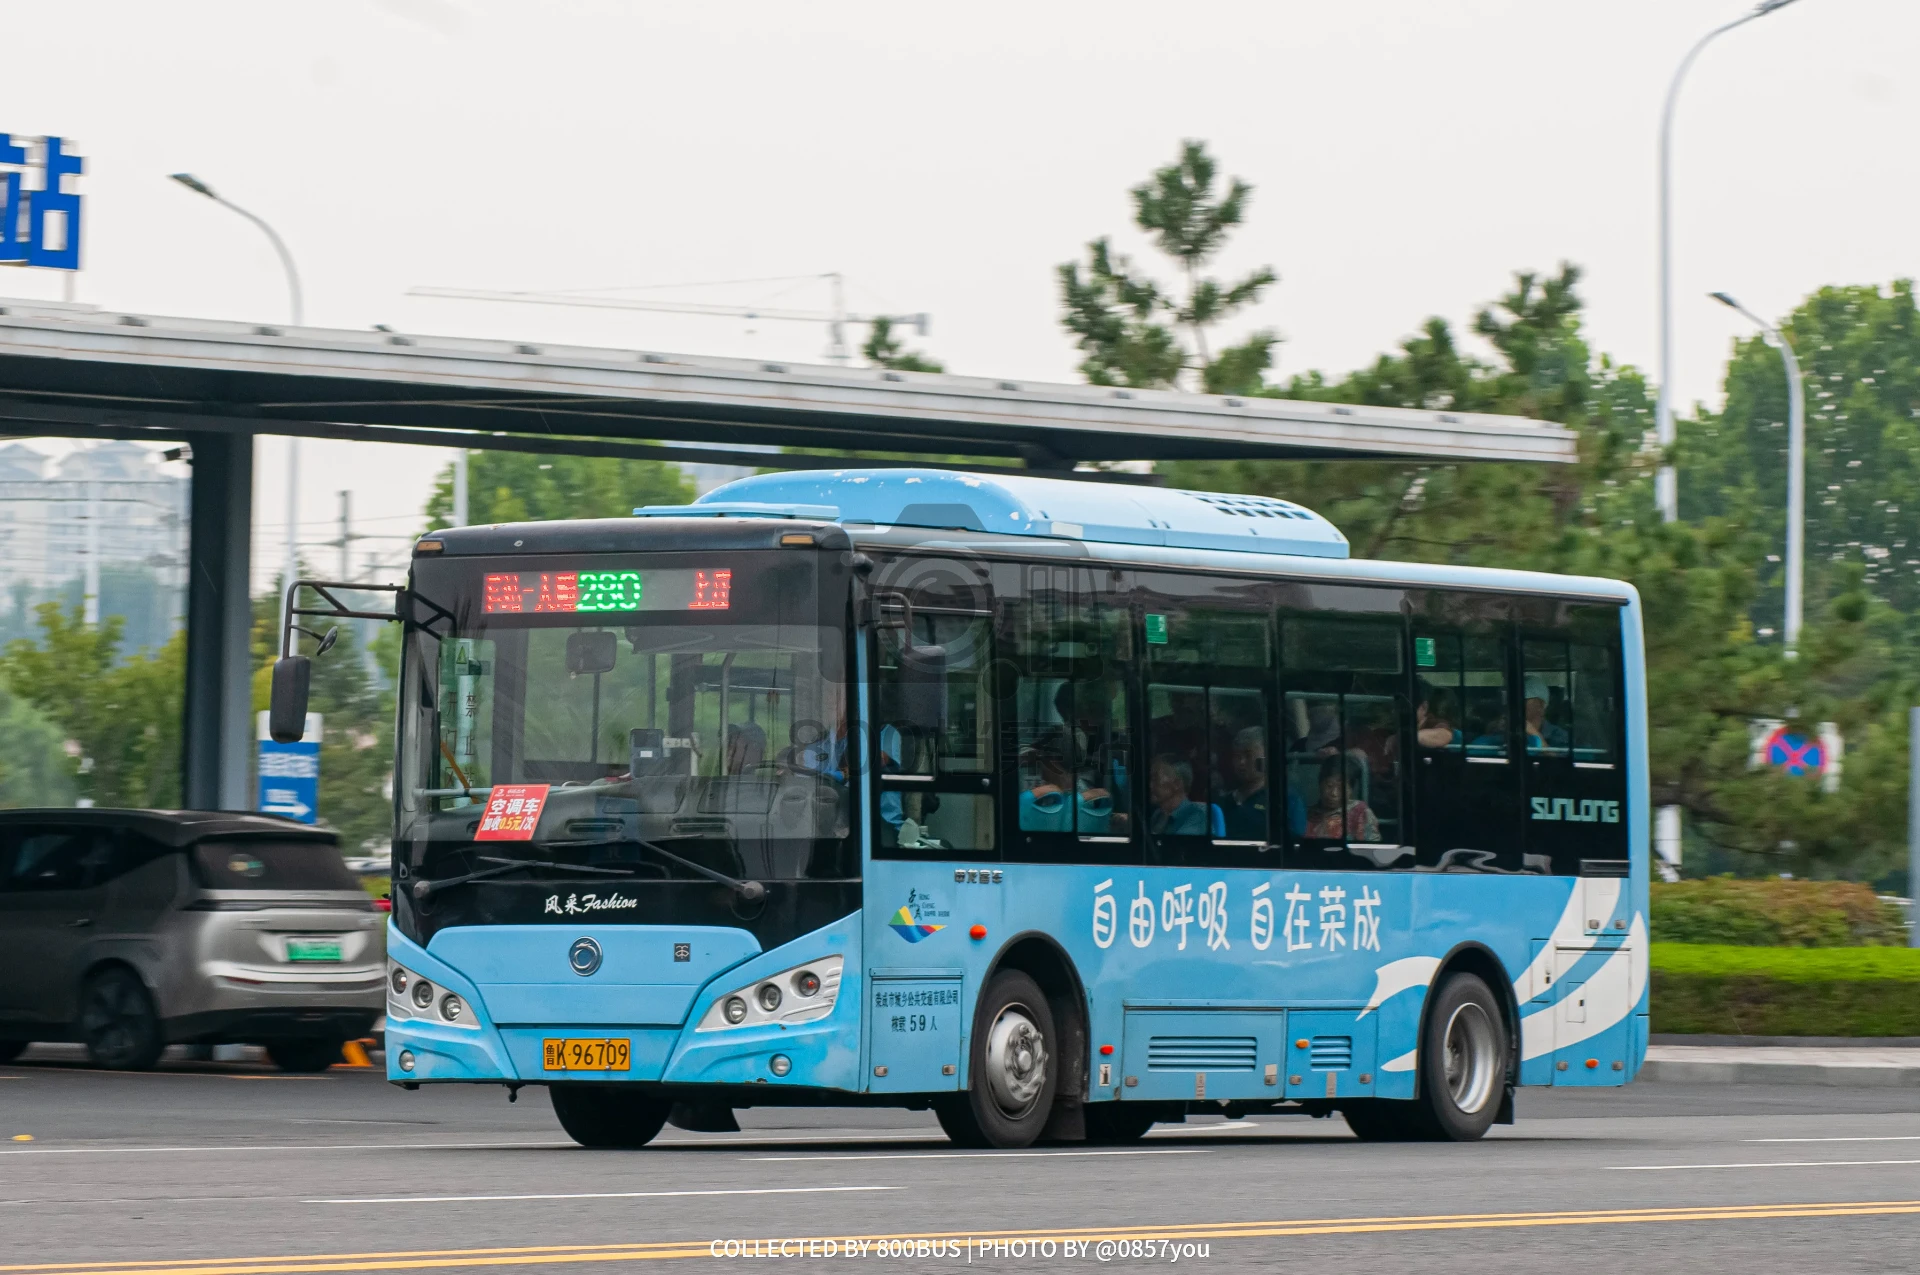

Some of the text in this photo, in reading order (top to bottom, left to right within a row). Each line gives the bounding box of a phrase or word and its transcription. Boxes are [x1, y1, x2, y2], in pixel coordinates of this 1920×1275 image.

[0, 133, 83, 270] 站
[577, 570, 641, 612] 280
[488, 797, 541, 815] 空调车
[1530, 796, 1620, 823] SUNLONG
[544, 892, 638, 915] 风采 Fashion
[1091, 878, 1382, 952] 自由呼吸 自在荣成
[910, 1014, 926, 1032] 59
[929, 1015, 938, 1031] 人
